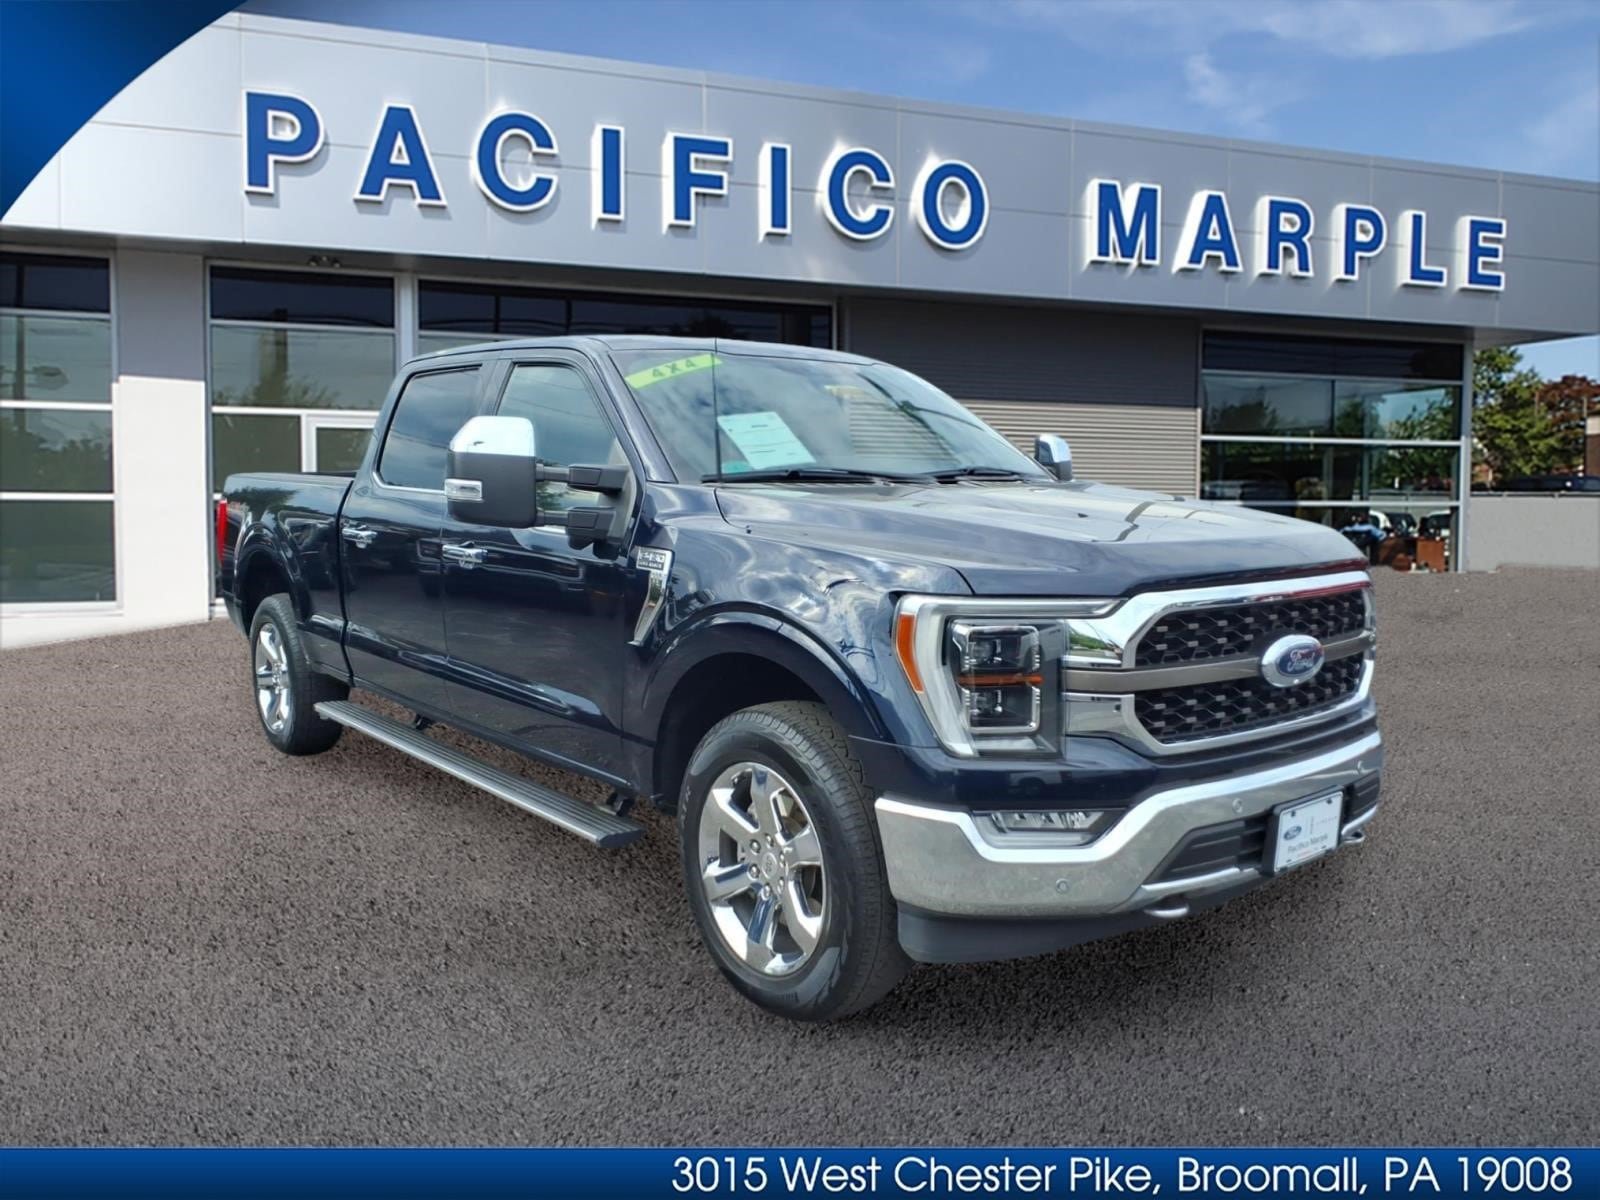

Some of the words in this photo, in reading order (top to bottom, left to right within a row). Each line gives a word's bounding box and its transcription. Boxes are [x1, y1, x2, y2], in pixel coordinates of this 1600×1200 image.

[245, 90, 988, 249] PACIFICO
[1091, 180, 1505, 289] MARPLE
[1287, 648, 1316, 673] Ford
